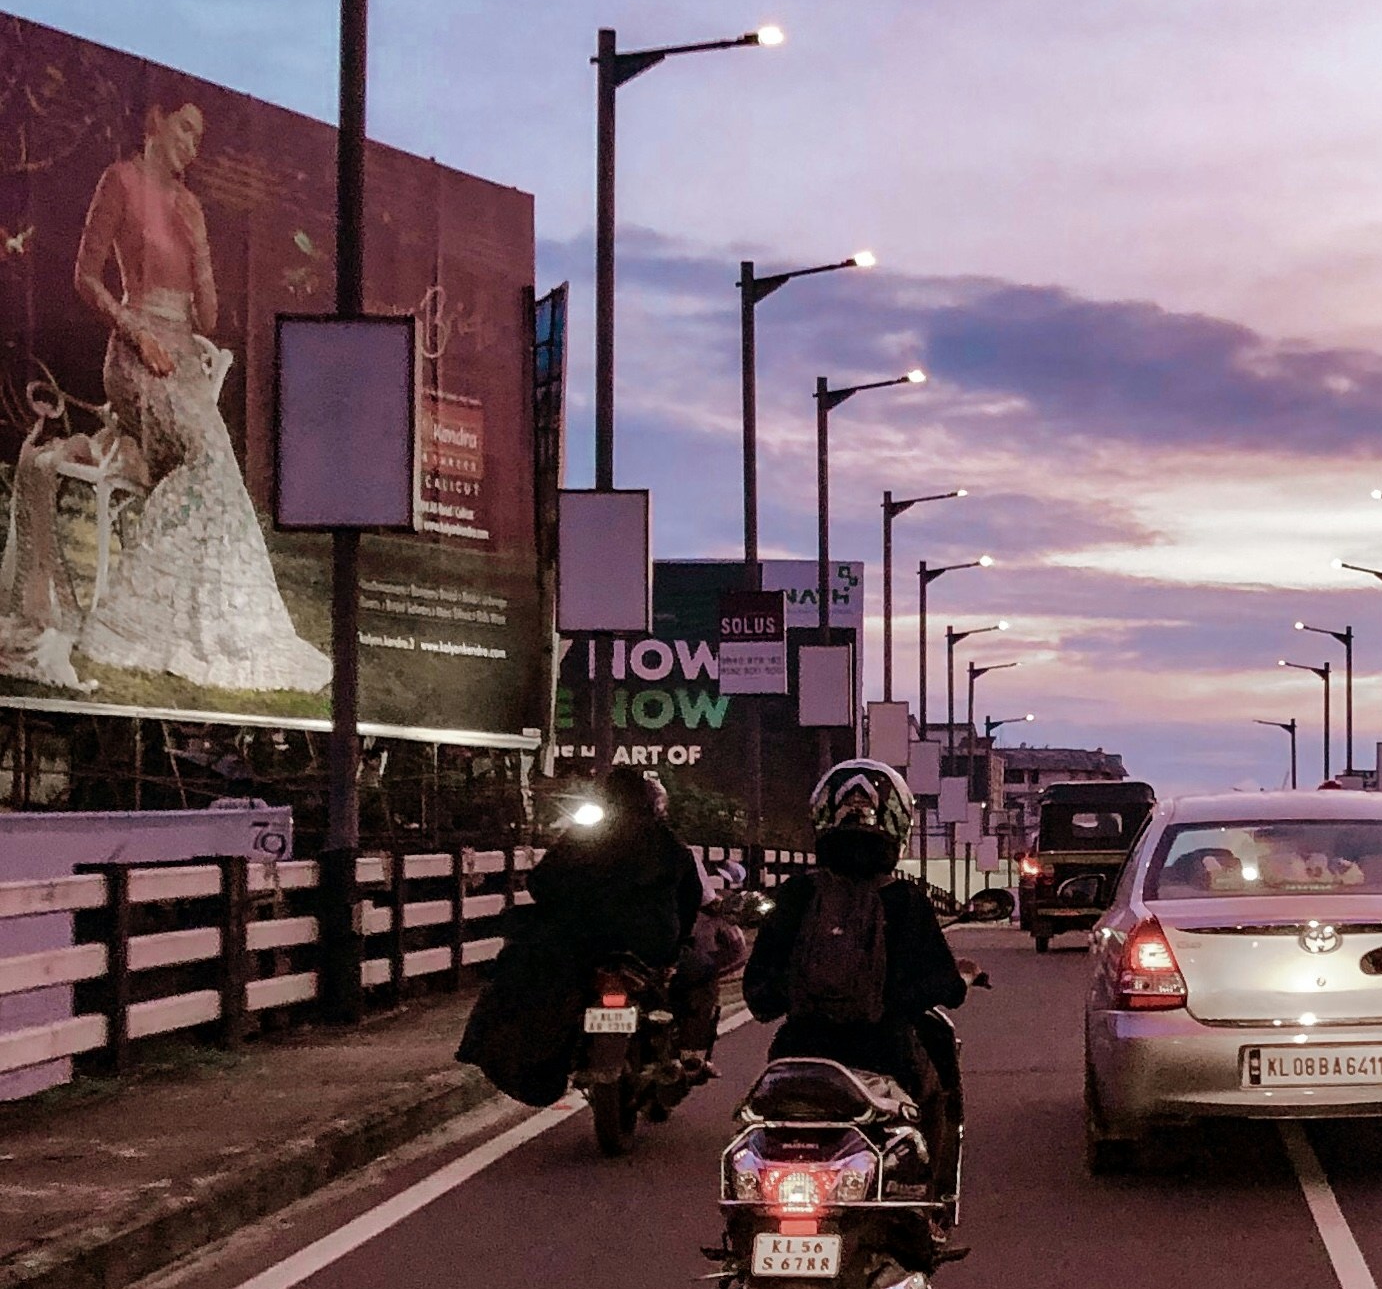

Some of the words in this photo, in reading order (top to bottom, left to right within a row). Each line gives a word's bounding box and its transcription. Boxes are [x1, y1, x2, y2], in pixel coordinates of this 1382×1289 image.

[721, 617, 776, 635] SOLUS
[667, 744, 702, 765] OF
[771, 1240, 793, 1254] KL
[801, 1241, 824, 1254] 56
